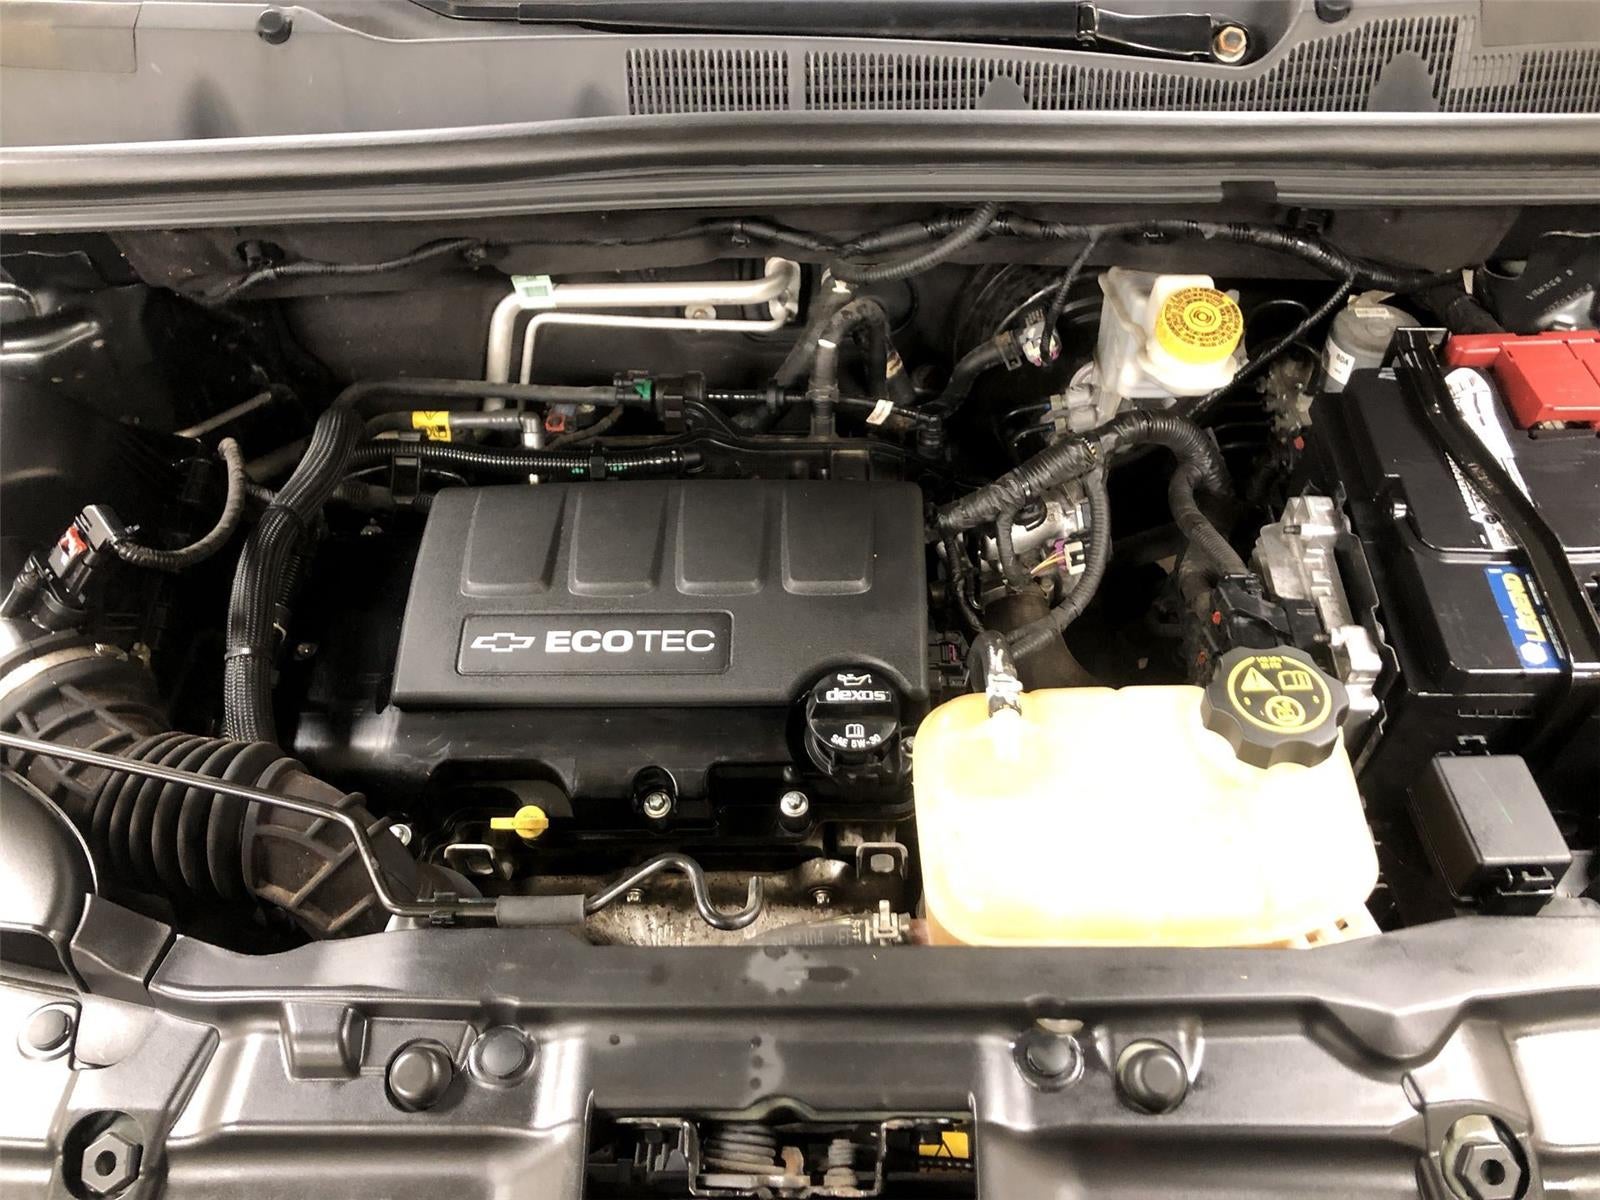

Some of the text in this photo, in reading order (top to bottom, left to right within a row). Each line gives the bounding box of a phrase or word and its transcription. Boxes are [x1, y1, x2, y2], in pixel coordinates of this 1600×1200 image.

[545, 629, 715, 653] ECOTEC
[825, 687, 887, 702] dexos
[830, 733, 848, 748] SAE
